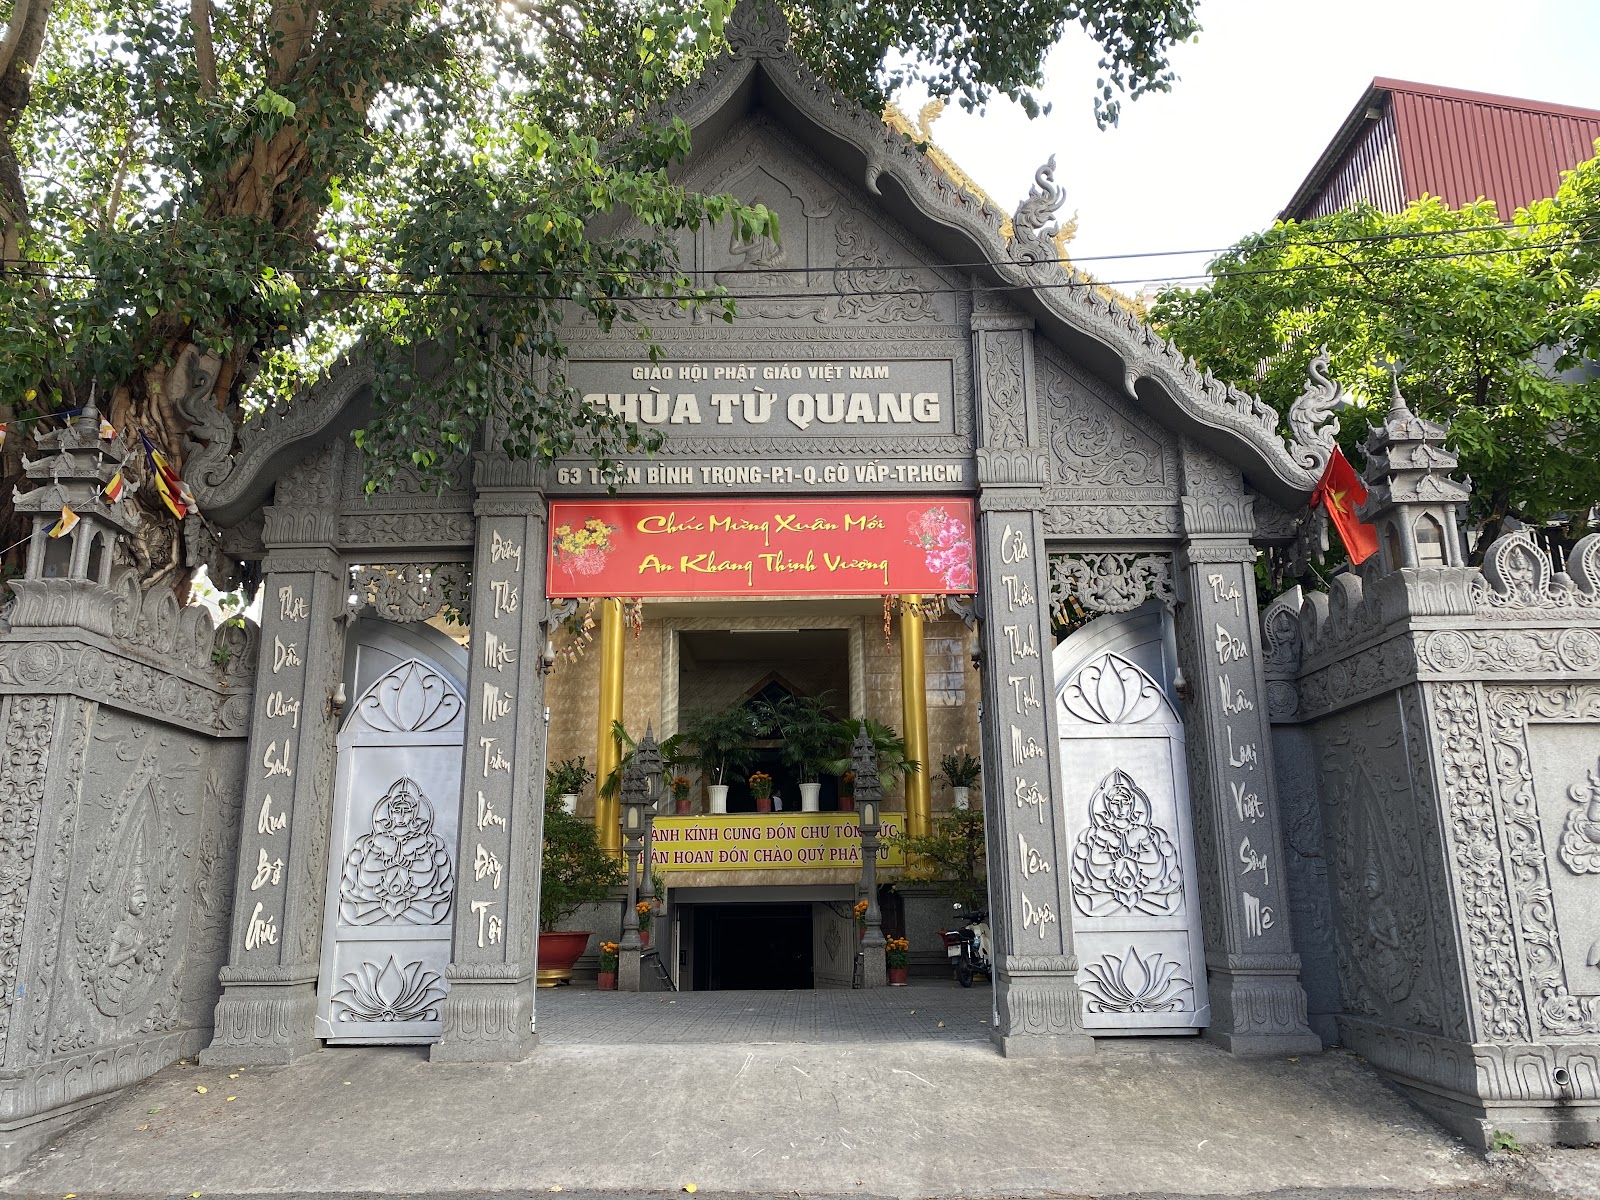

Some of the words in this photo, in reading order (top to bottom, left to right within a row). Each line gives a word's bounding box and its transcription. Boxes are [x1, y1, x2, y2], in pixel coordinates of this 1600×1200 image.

[632, 364, 674, 380] GIÁO
[679, 364, 708, 382] HỘI
[714, 364, 757, 382] PHẬT
[763, 363, 802, 379] GIÁO
[808, 365, 844, 382] VIỆT
[850, 365, 889, 379] NAM
[710, 386, 778, 424] TỪ
[787, 393, 940, 430] QUANG
[557, 467, 582, 484] 63
[647, 462, 693, 484] BÌNH
[636, 511, 704, 534] Chúc
[709, 514, 769, 546] Mừng
[774, 513, 839, 533] Xuân
[844, 513, 886, 532] Mới
[1002, 525, 1028, 563] Cửa
[638, 553, 674, 574] An
[680, 550, 753, 587] Khang
[758, 549, 817, 573] Thịnh
[822, 551, 889, 586] Vượng
[279, 585, 307, 622] Phật
[491, 580, 518, 618] Thế
[1002, 575, 1034, 611] Thiền
[1209, 574, 1241, 615] Pháp
[274, 635, 301, 673] Dẫn
[485, 631, 515, 672] Mịt
[1004, 624, 1039, 664] Thanh
[267, 691, 299, 728] Chúng
[483, 683, 512, 724] Mù
[1009, 675, 1040, 715] Tịnh
[1219, 674, 1253, 716] Nhân
[264, 739, 291, 778] Sanh
[481, 737, 510, 777] Trăm
[1011, 725, 1044, 766] Muôn
[1227, 726, 1257, 770] Loại
[258, 794, 286, 835] Qua
[478, 791, 506, 832] Năm
[1016, 777, 1047, 823] Kiếp
[1231, 781, 1264, 823] Vượt
[639, 825, 679, 842] ÀNH
[685, 824, 718, 841] KÍNH
[724, 827, 761, 840] CUNG
[766, 822, 796, 839] ĐÓN
[801, 825, 830, 839] CHƯ
[475, 844, 503, 889] Đầy
[674, 851, 714, 864] HOAN
[719, 845, 749, 863] ĐÓN
[753, 845, 793, 862] CHÀO
[797, 844, 826, 864] QUÝ
[1019, 834, 1051, 879] Nên
[1240, 837, 1268, 885] Sông
[246, 902, 278, 950] Giác
[471, 900, 501, 947] Tội
[1022, 892, 1055, 938] Duyên
[1243, 892, 1274, 937] Mê
